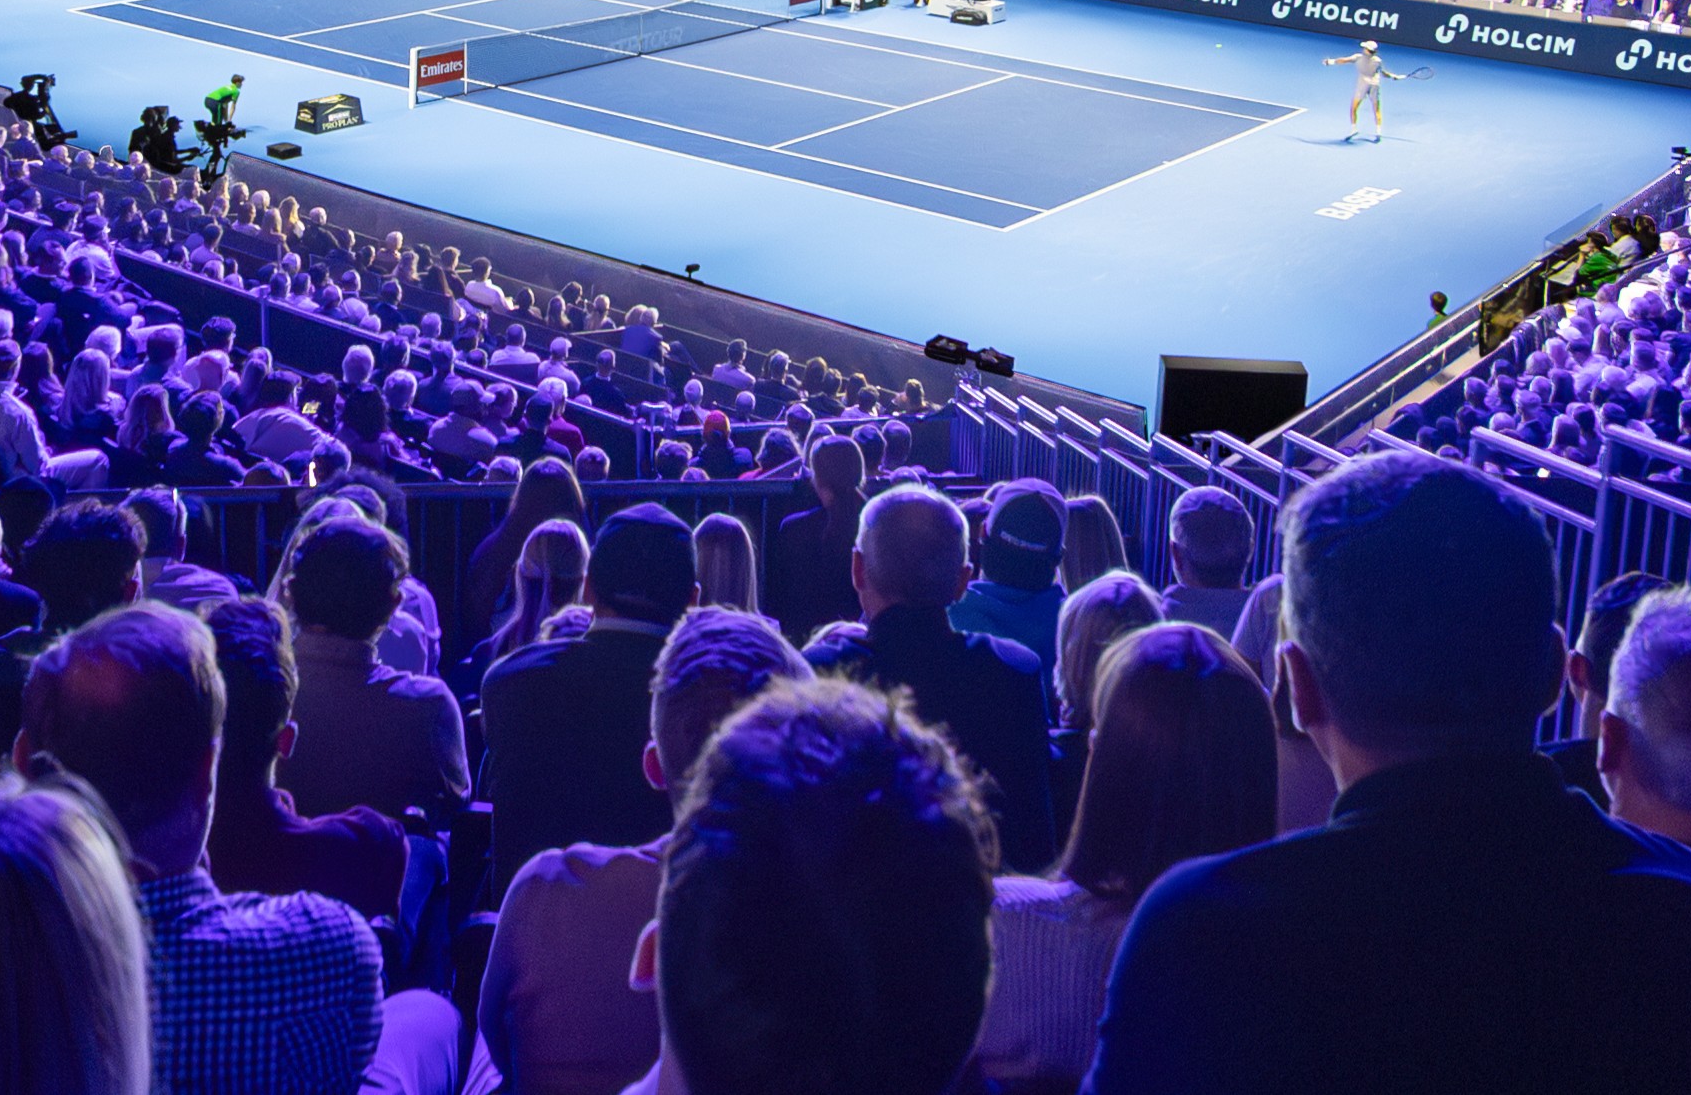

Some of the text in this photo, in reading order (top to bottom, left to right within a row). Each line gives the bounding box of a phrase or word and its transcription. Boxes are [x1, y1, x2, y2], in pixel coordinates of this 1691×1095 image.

[1304, 1, 1399, 30] HOLCIM
[1472, 25, 1576, 56] HOLCIM
[420, 59, 463, 78] Emirates
[1314, 186, 1403, 221] BASEL
